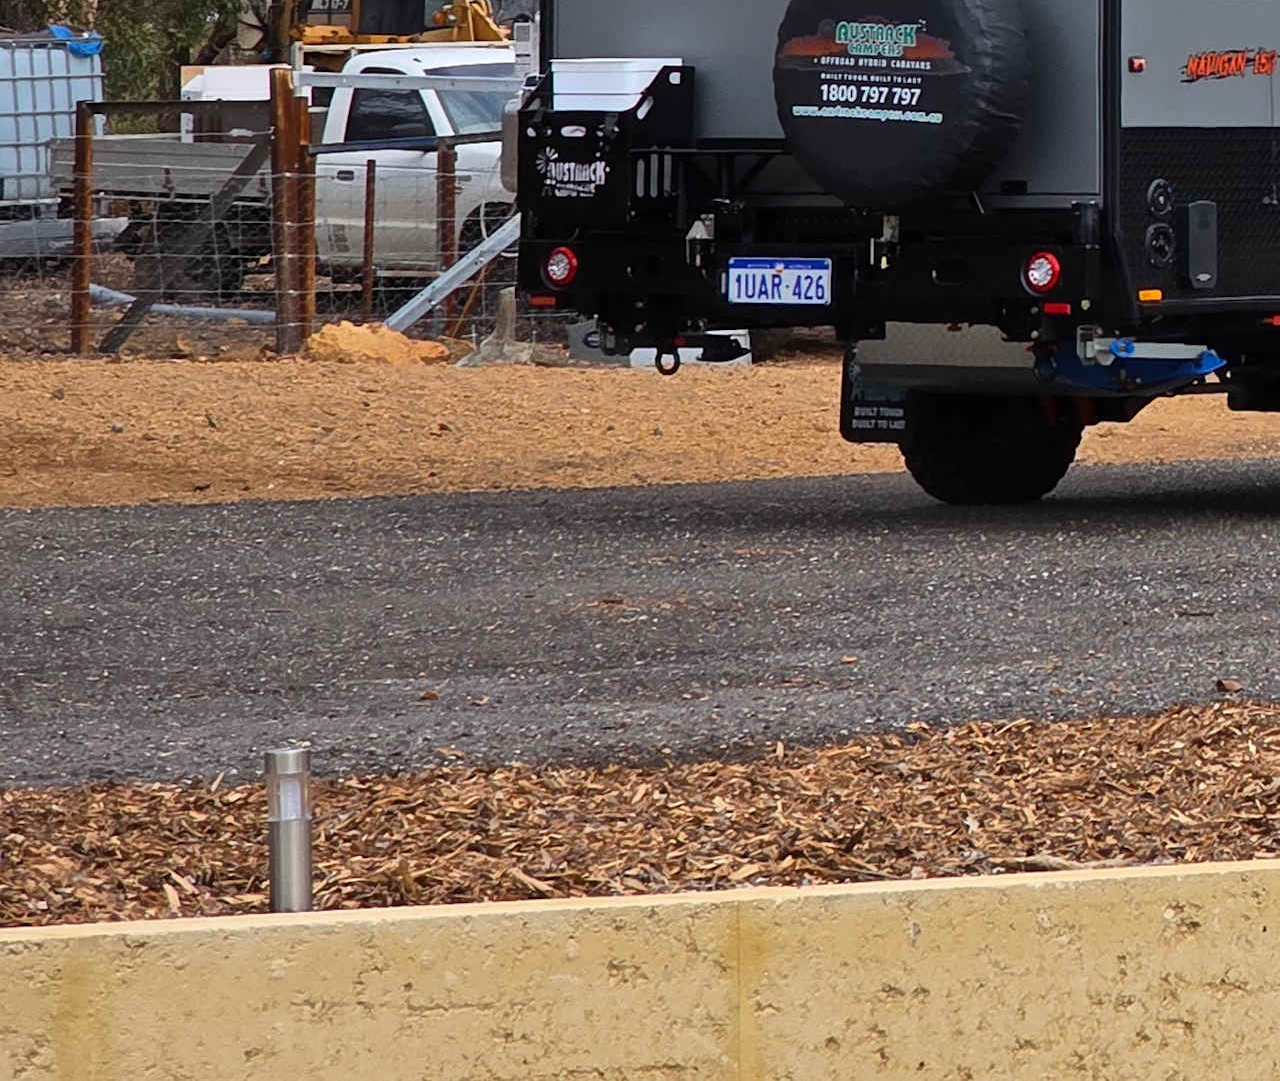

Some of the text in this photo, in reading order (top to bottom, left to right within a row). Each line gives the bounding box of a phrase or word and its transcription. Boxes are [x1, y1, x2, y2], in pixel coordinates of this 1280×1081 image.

[836, 21, 918, 47] AUSTRACK
[848, 42, 904, 57] CAMPERS
[820, 56, 855, 66] OFFROAD
[858, 57, 887, 68] HYBRID
[890, 59, 931, 70] CARAVANS
[1186, 52, 1247, 78] MADIGAN
[820, 84, 921, 106] 1800 797 797
